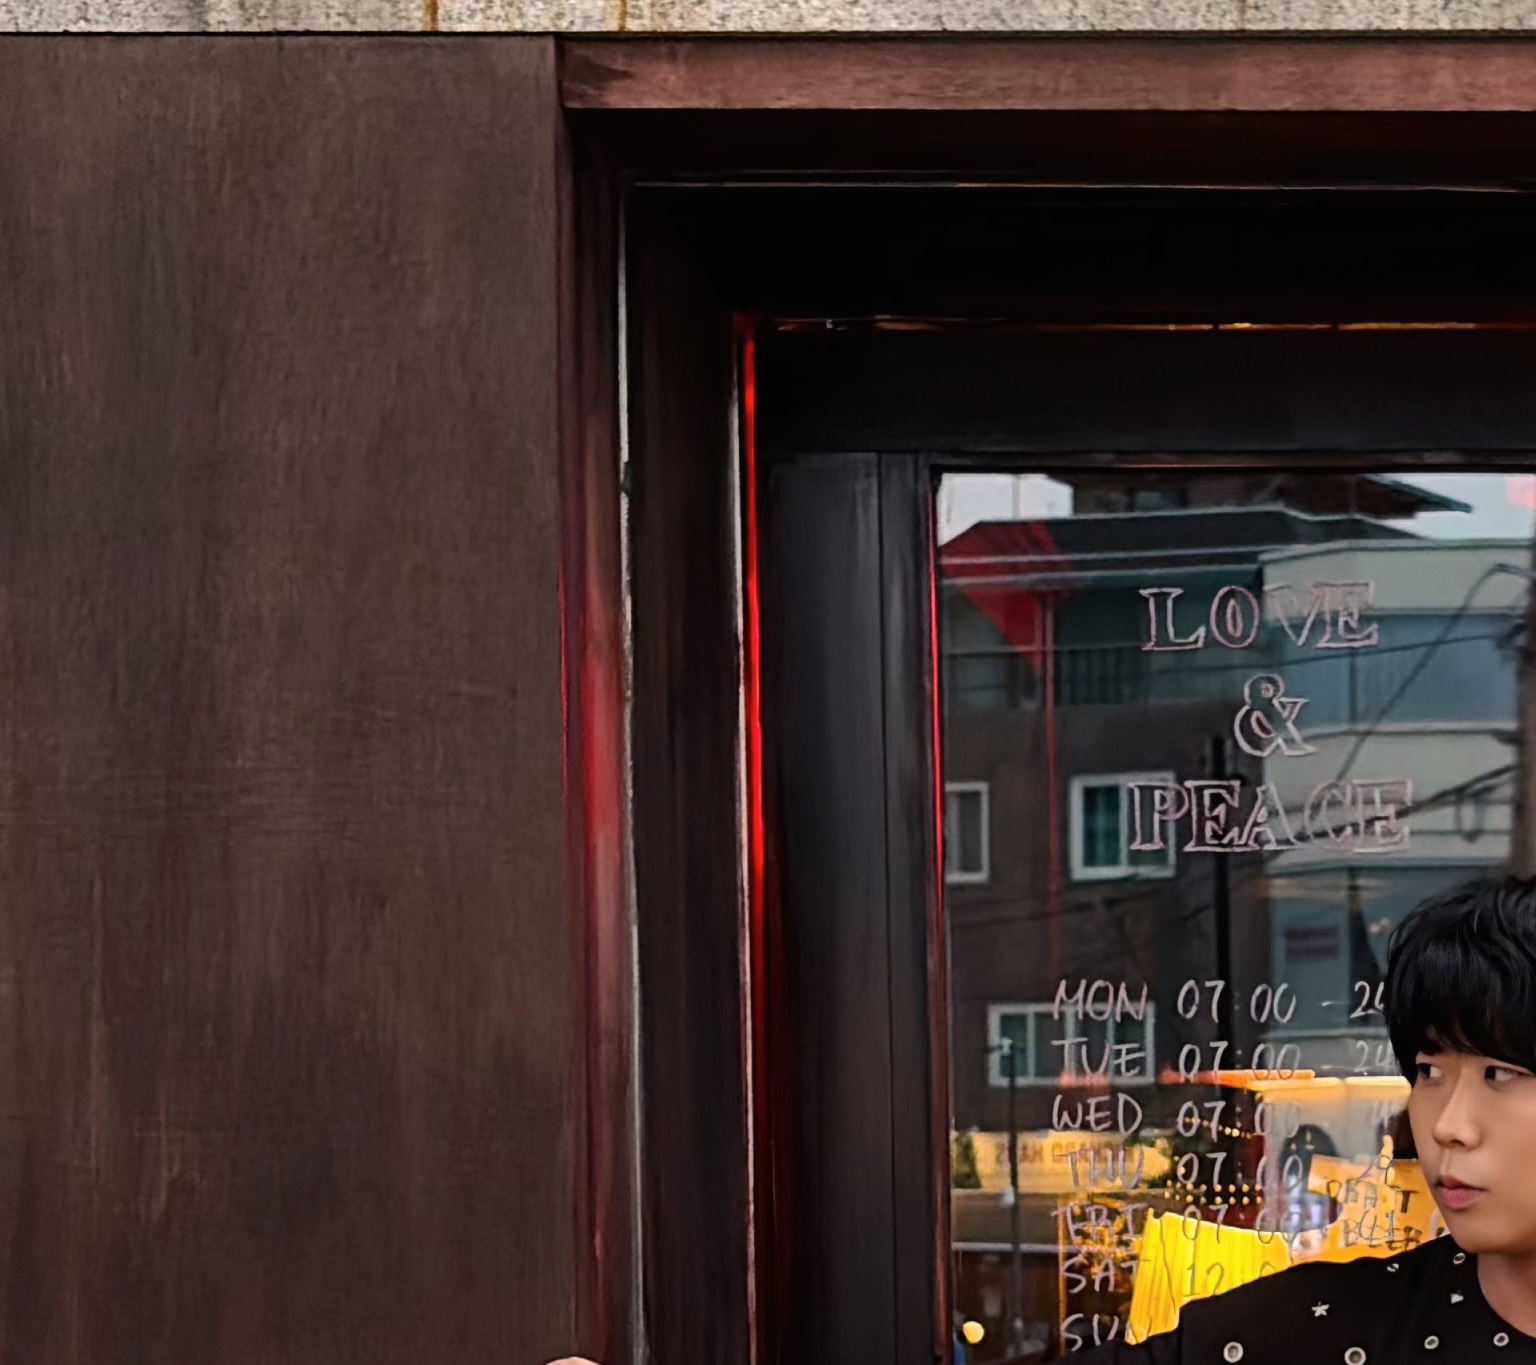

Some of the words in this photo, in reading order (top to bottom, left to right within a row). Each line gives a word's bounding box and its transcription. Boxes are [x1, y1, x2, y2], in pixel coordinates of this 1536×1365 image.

[1138, 581, 1380, 650] LOVE
[1233, 674, 1316, 757] &
[1128, 778, 1412, 853] PEACE
[1053, 978, 1148, 1023] MON
[1051, 1036, 1148, 1078] TUE
[1052, 1093, 1144, 1136] WED
[1057, 1146, 1145, 1190] THU
[1052, 1203, 1148, 1243] FRI
[1063, 1254, 1152, 1293] SAT
[1060, 1312, 1131, 1351] SU
